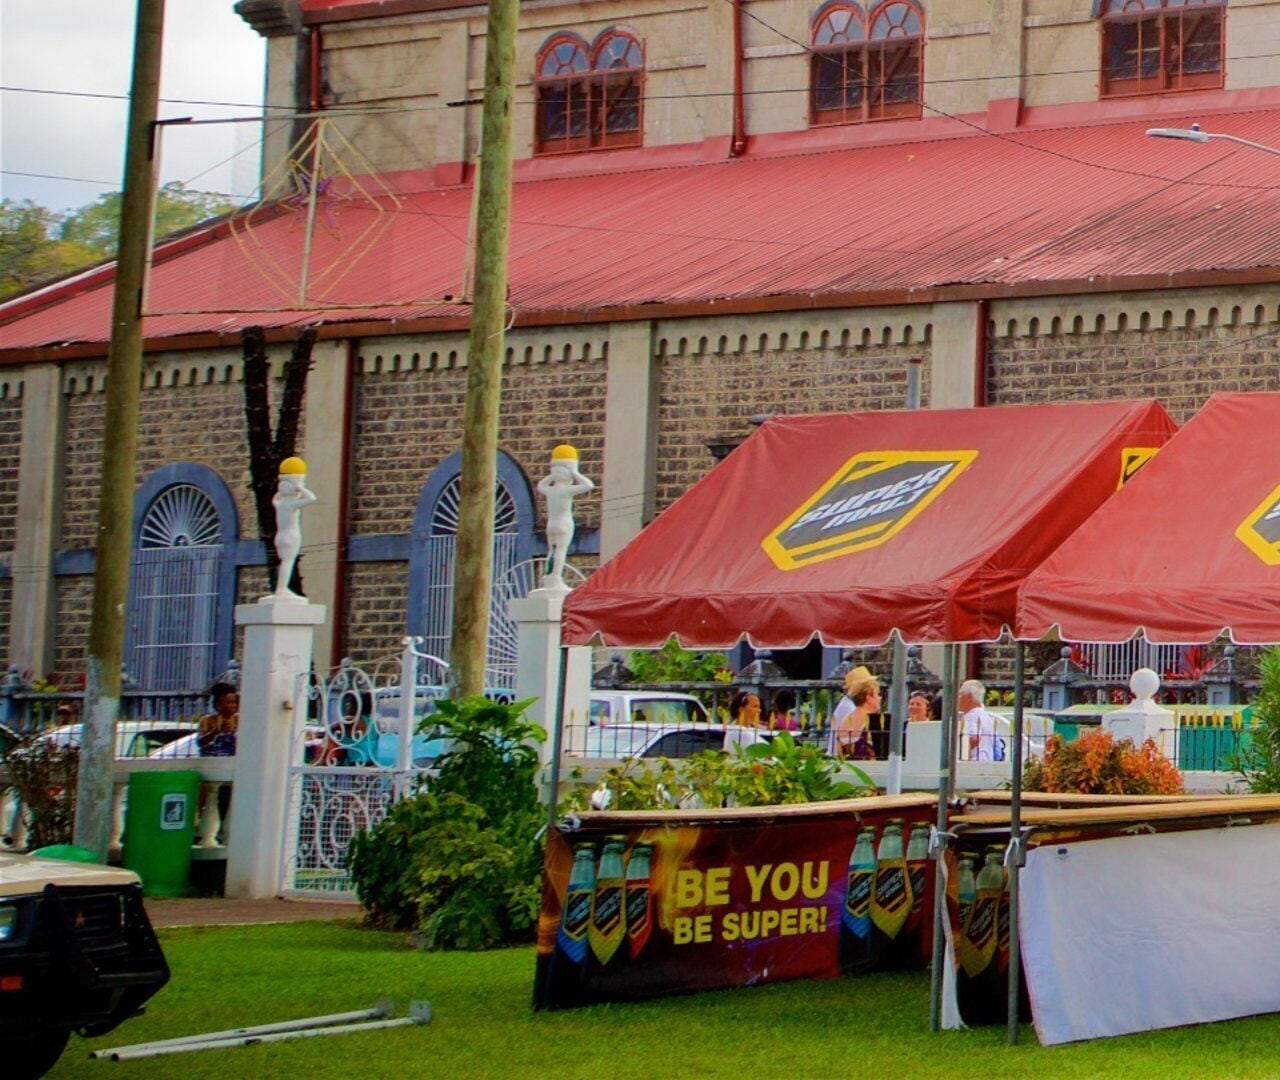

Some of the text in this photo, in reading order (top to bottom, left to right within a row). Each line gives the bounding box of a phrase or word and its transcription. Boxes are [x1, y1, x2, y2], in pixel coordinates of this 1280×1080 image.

[788, 462, 954, 532] SUPER
[821, 485, 934, 531] MALT
[676, 867, 731, 909] BE
[745, 860, 829, 902] YOU
[673, 906, 828, 945] BE SUPER!
